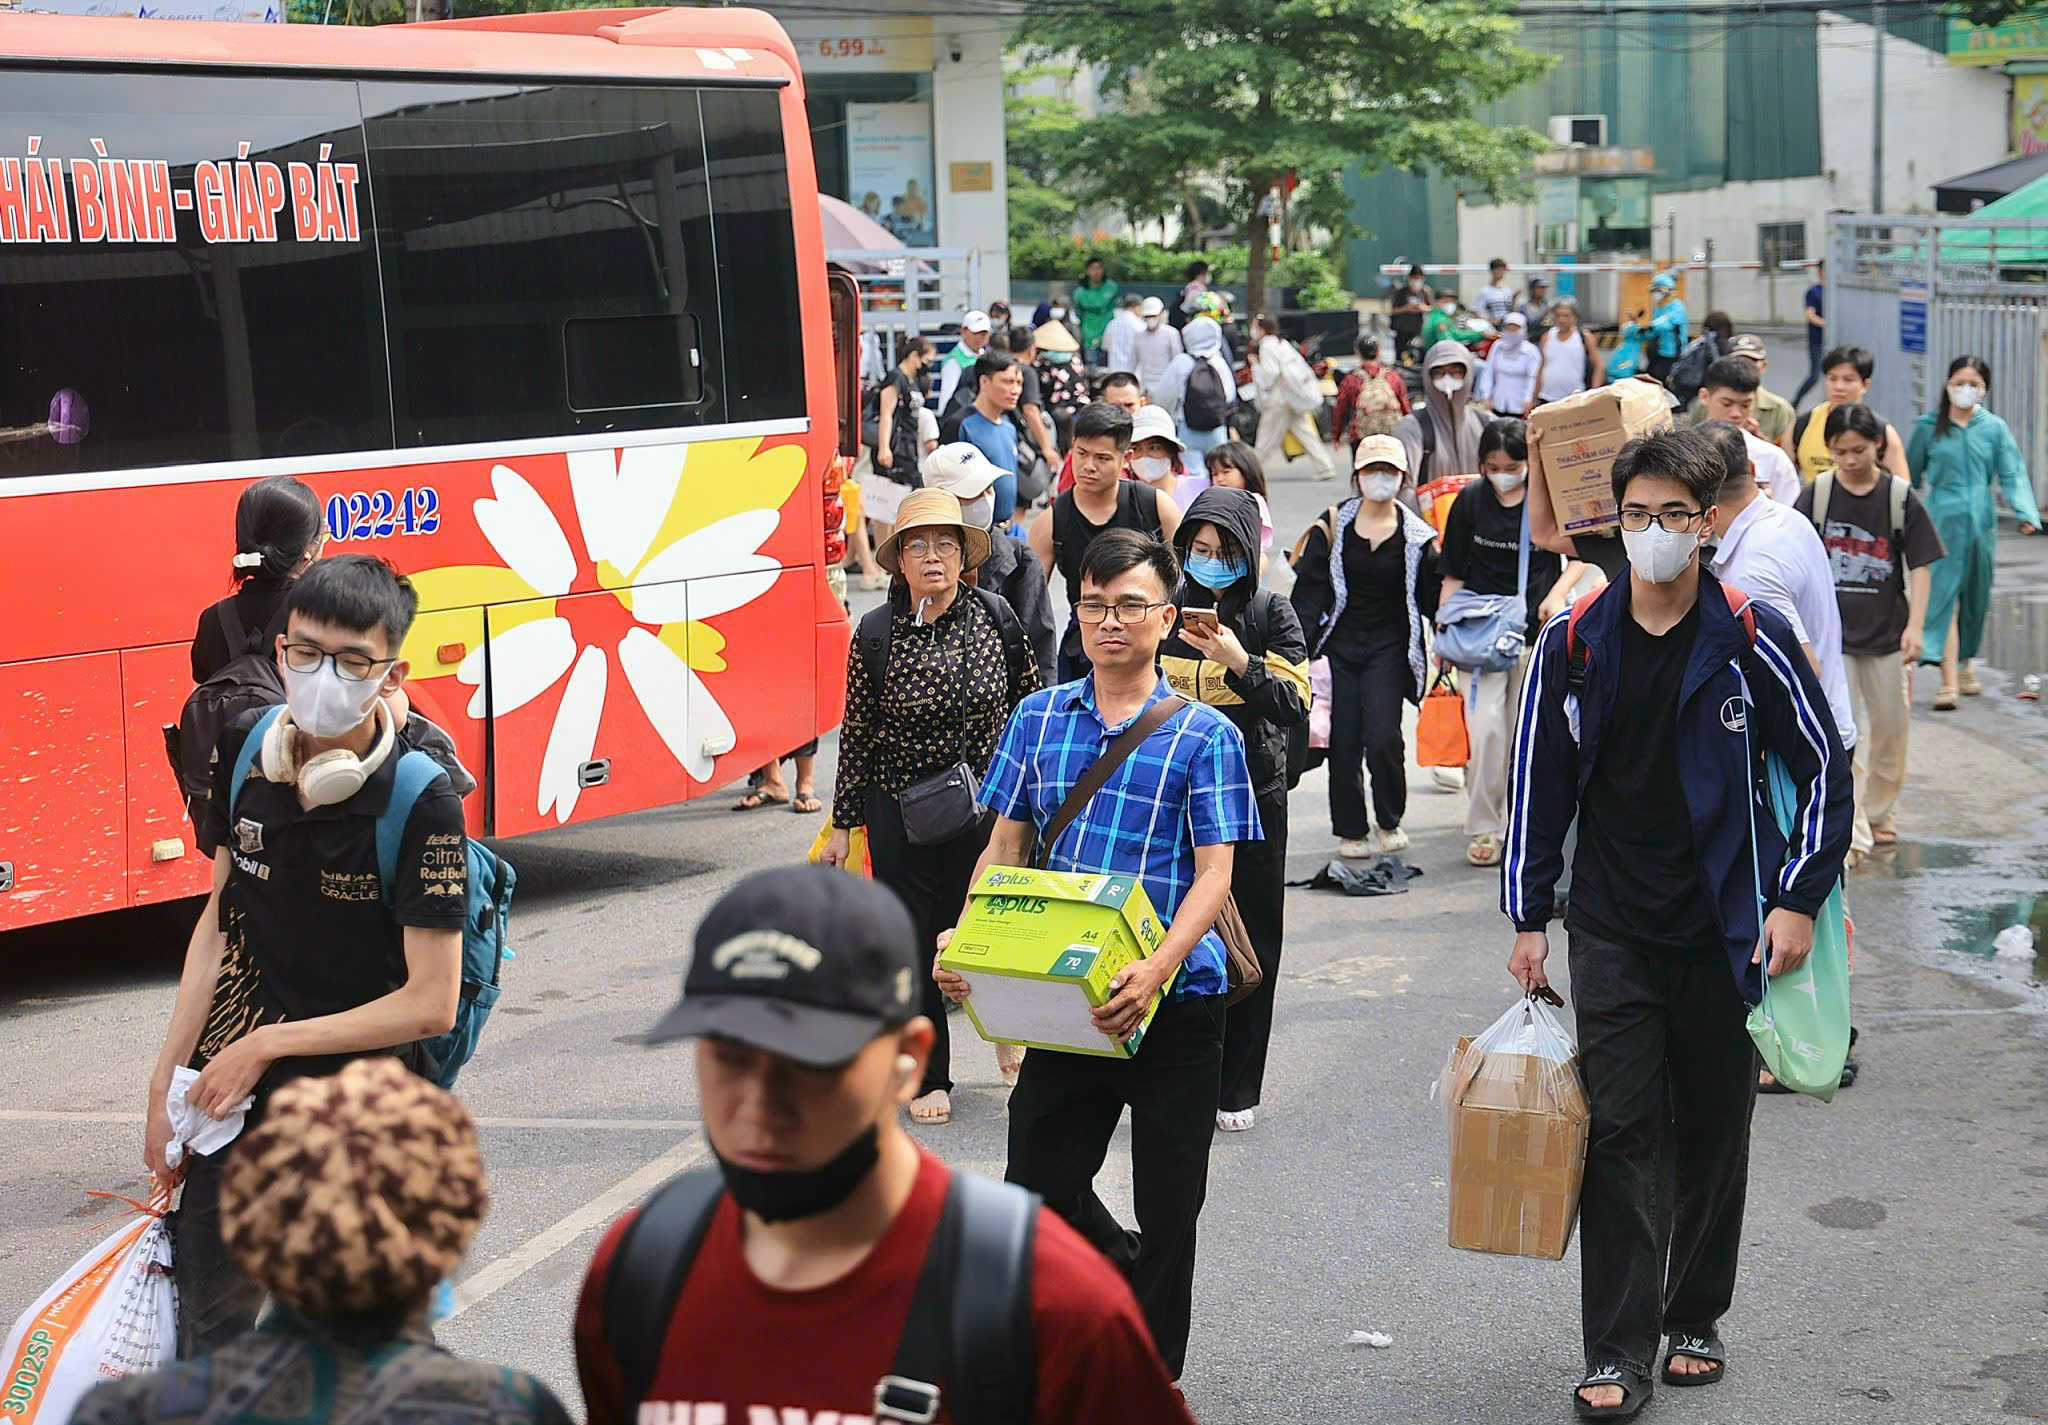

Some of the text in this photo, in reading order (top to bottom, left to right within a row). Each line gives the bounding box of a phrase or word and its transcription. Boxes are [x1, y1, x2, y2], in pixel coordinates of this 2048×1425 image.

[819, 38, 864, 58] 6,99
[288, 143, 361, 243] BÁT
[325, 486, 441, 542] 02242
[944, 645, 974, 656] Supree
[422, 848, 465, 865] citrix
[320, 885, 379, 901] ORACLE
[1079, 880, 1091, 892] A4
[1106, 884, 1122, 896] 70
[1080, 930, 1099, 939] A4
[1065, 956, 1082, 967] 70
[2, 1328, 56, 1416] 3002SP
